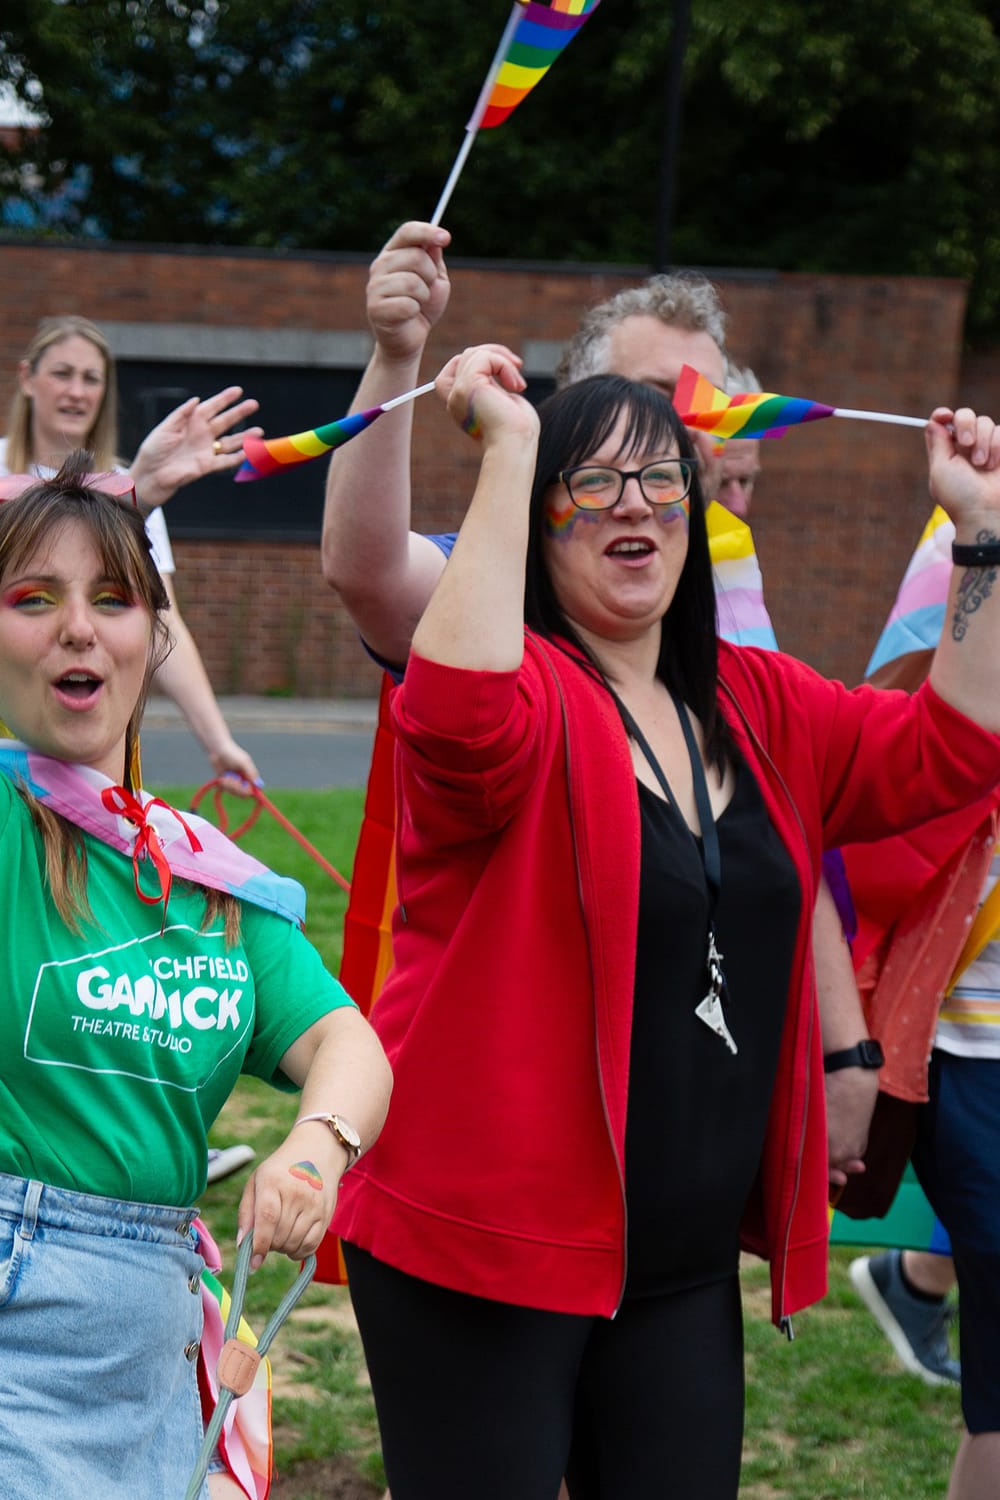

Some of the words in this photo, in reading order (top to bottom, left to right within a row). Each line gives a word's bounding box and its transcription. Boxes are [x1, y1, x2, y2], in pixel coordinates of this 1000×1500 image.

[149, 955, 249, 983] CHFIELD
[71, 1015, 140, 1041] THEATRE
[142, 1025, 151, 1042] &
